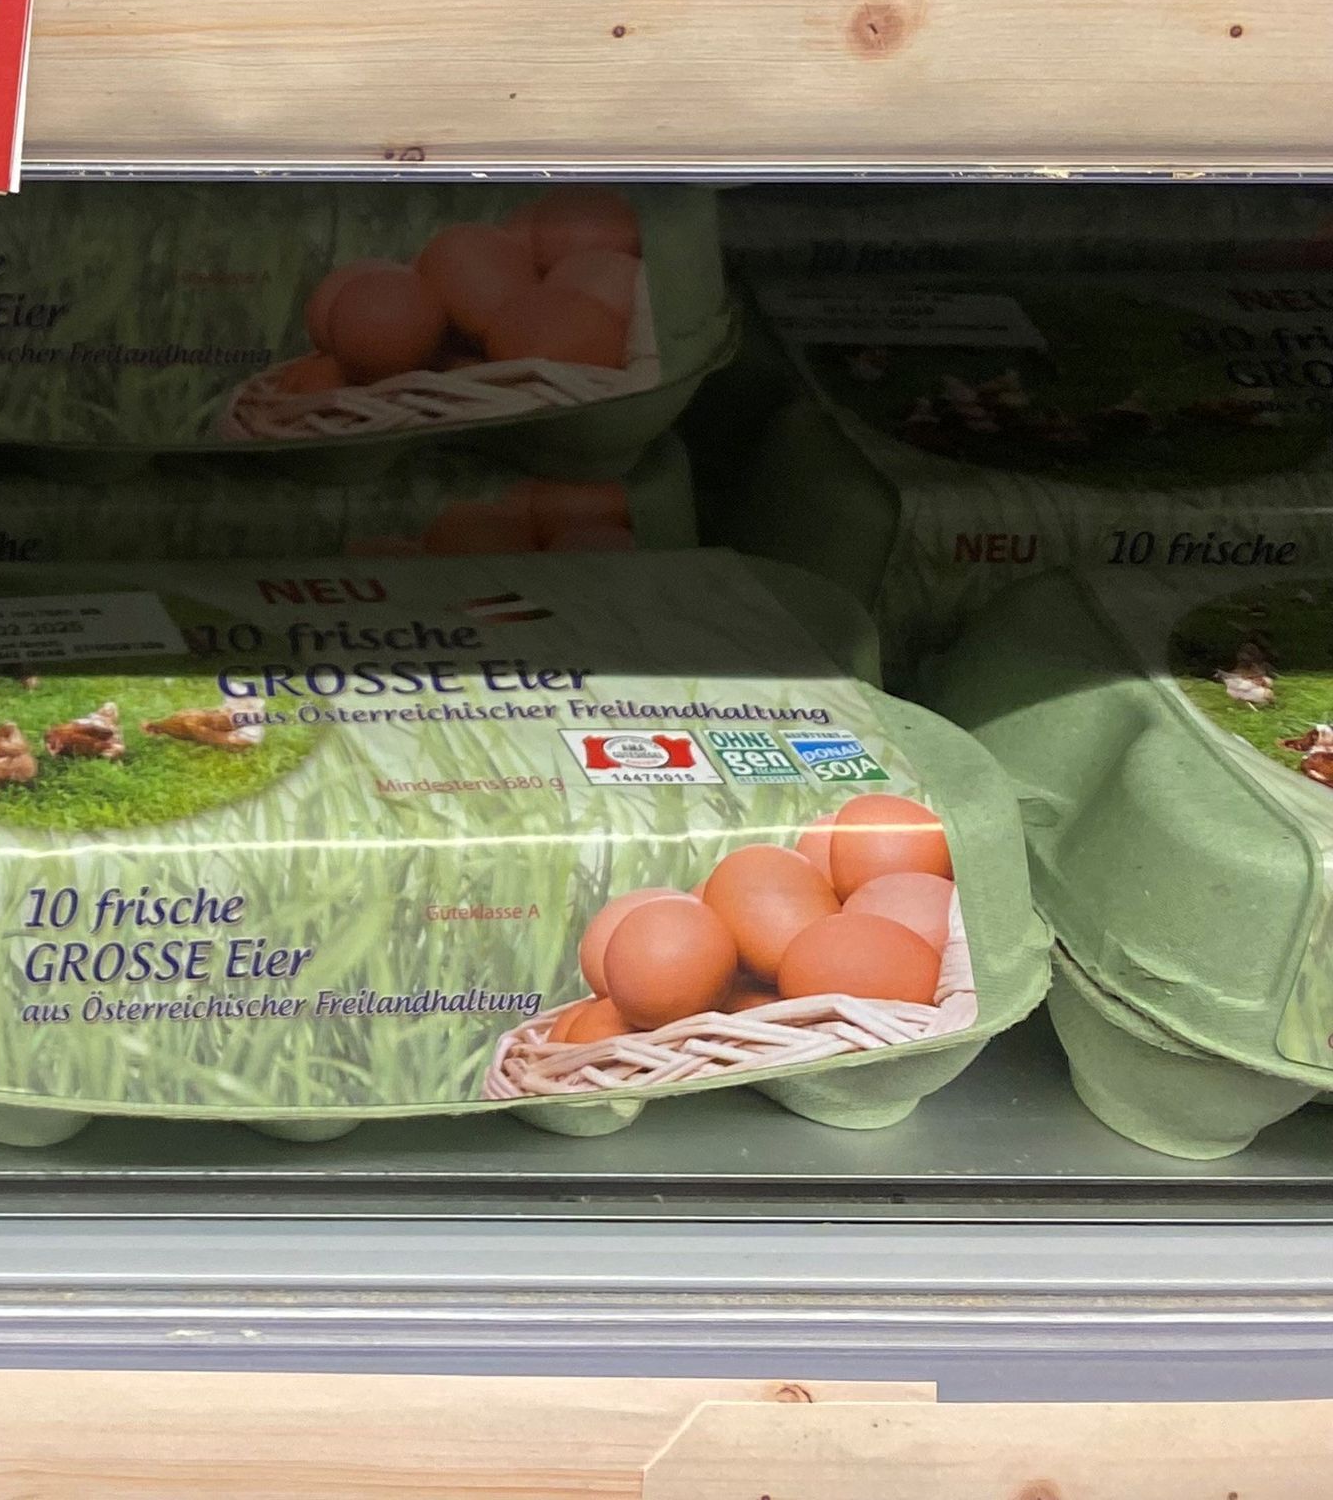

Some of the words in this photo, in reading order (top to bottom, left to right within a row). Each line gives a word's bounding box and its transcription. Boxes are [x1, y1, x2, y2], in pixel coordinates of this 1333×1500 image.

[955, 534, 1038, 564] NEU
[1106, 531, 1156, 565] 10
[1165, 531, 1297, 569] frische
[256, 578, 388, 604] NEU
[286, 620, 483, 655] frische
[218, 660, 465, 698] GROSSE
[480, 658, 594, 692] Eier
[298, 699, 557, 726] Österreichischer
[568, 698, 831, 726] Freilandhaltung
[710, 731, 777, 749] OHNE
[804, 742, 863, 761] DONAU
[723, 751, 789, 775] gen
[814, 759, 880, 781] SOJA
[375, 777, 499, 795] Mindestens
[505, 776, 544, 792] 680
[23, 887, 77, 928] 10
[91, 887, 244, 935] frische
[24, 939, 212, 984] GROSSE
[225, 938, 313, 982] Eier
[22, 1000, 71, 1024] aus
[81, 990, 307, 1026] Österreichischer
[315, 987, 542, 1019] Freilandhaltung
